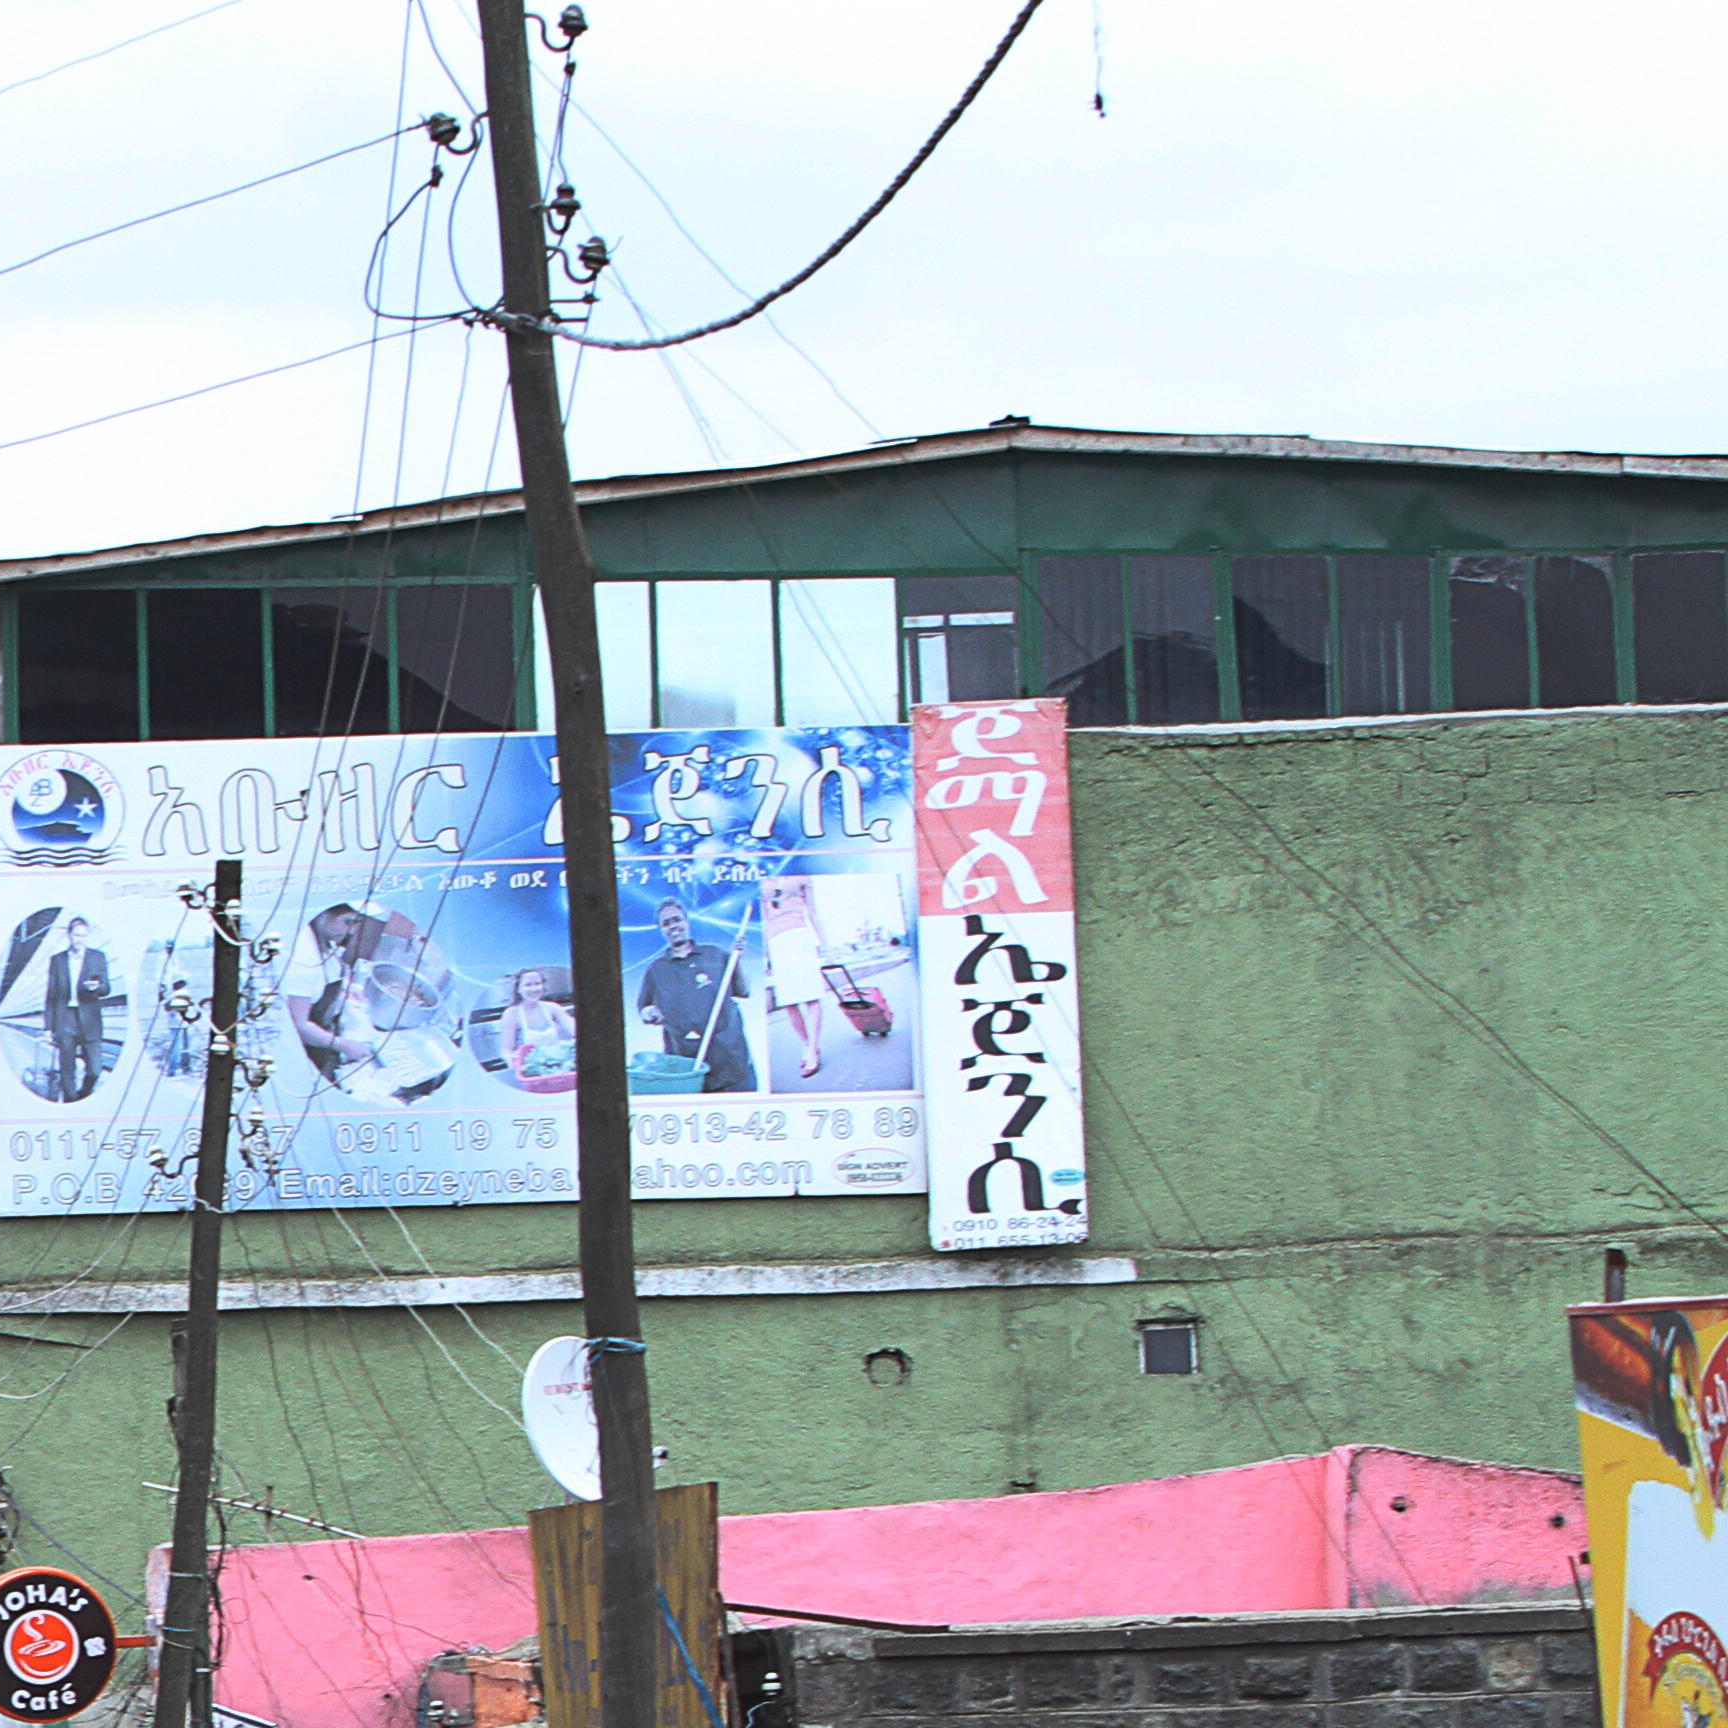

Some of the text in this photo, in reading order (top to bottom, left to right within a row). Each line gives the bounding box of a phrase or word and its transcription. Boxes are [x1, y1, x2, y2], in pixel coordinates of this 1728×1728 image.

[924, 702, 1049, 910] ጀማል
[953, 914, 1085, 1214] ኤጀንሲ
[9, 1127, 162, 1162] 0111-57
[334, 1121, 423, 1153] 0911
[448, 1119, 493, 1151] 19
[511, 1118, 559, 1149] 75
[806, 1108, 855, 1140] 78
[873, 1105, 920, 1139] 89
[12, 1171, 121, 1206] P.O.B
[952, 1218, 998, 1232] 0910
[10, 1682, 77, 1712] Café
